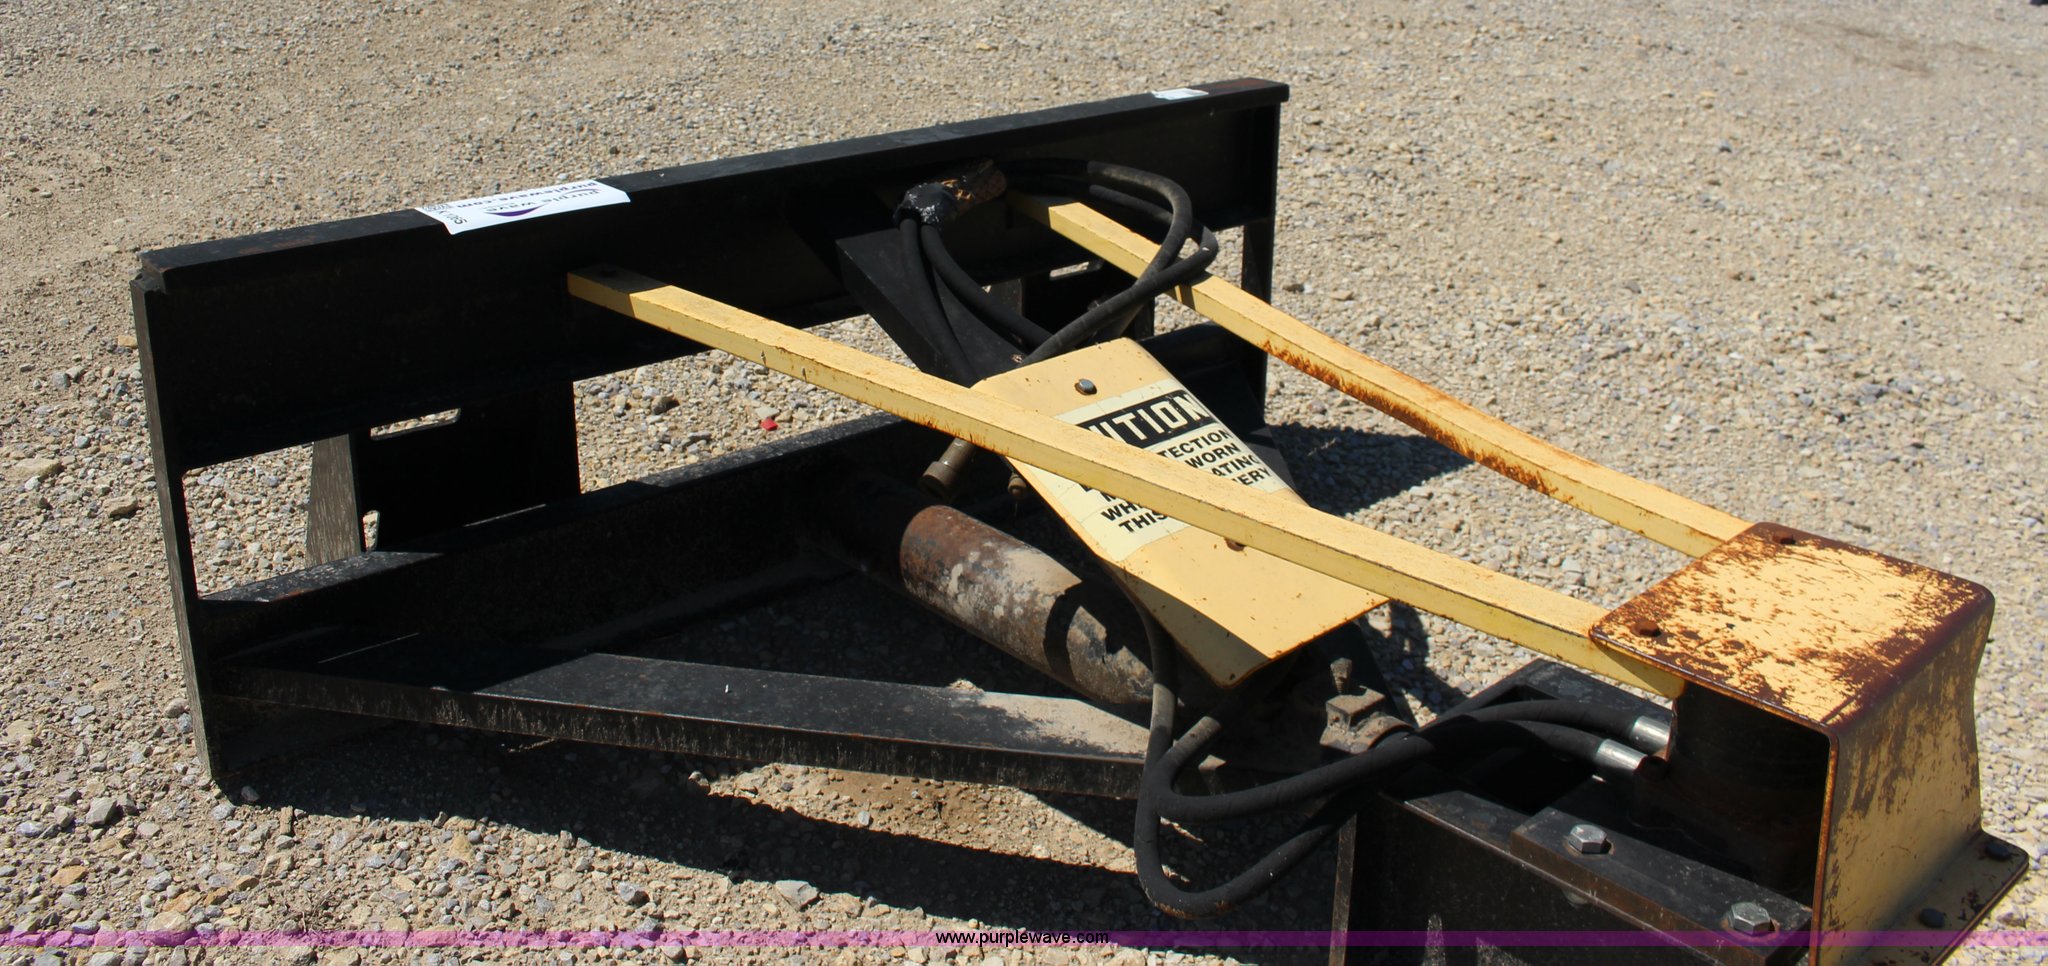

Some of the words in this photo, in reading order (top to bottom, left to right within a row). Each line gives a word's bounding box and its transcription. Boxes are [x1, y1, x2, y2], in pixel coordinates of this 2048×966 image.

[1088, 393, 1211, 443] UTION
[1156, 429, 1234, 458] TECTION
[1184, 442, 1242, 469] WORN
